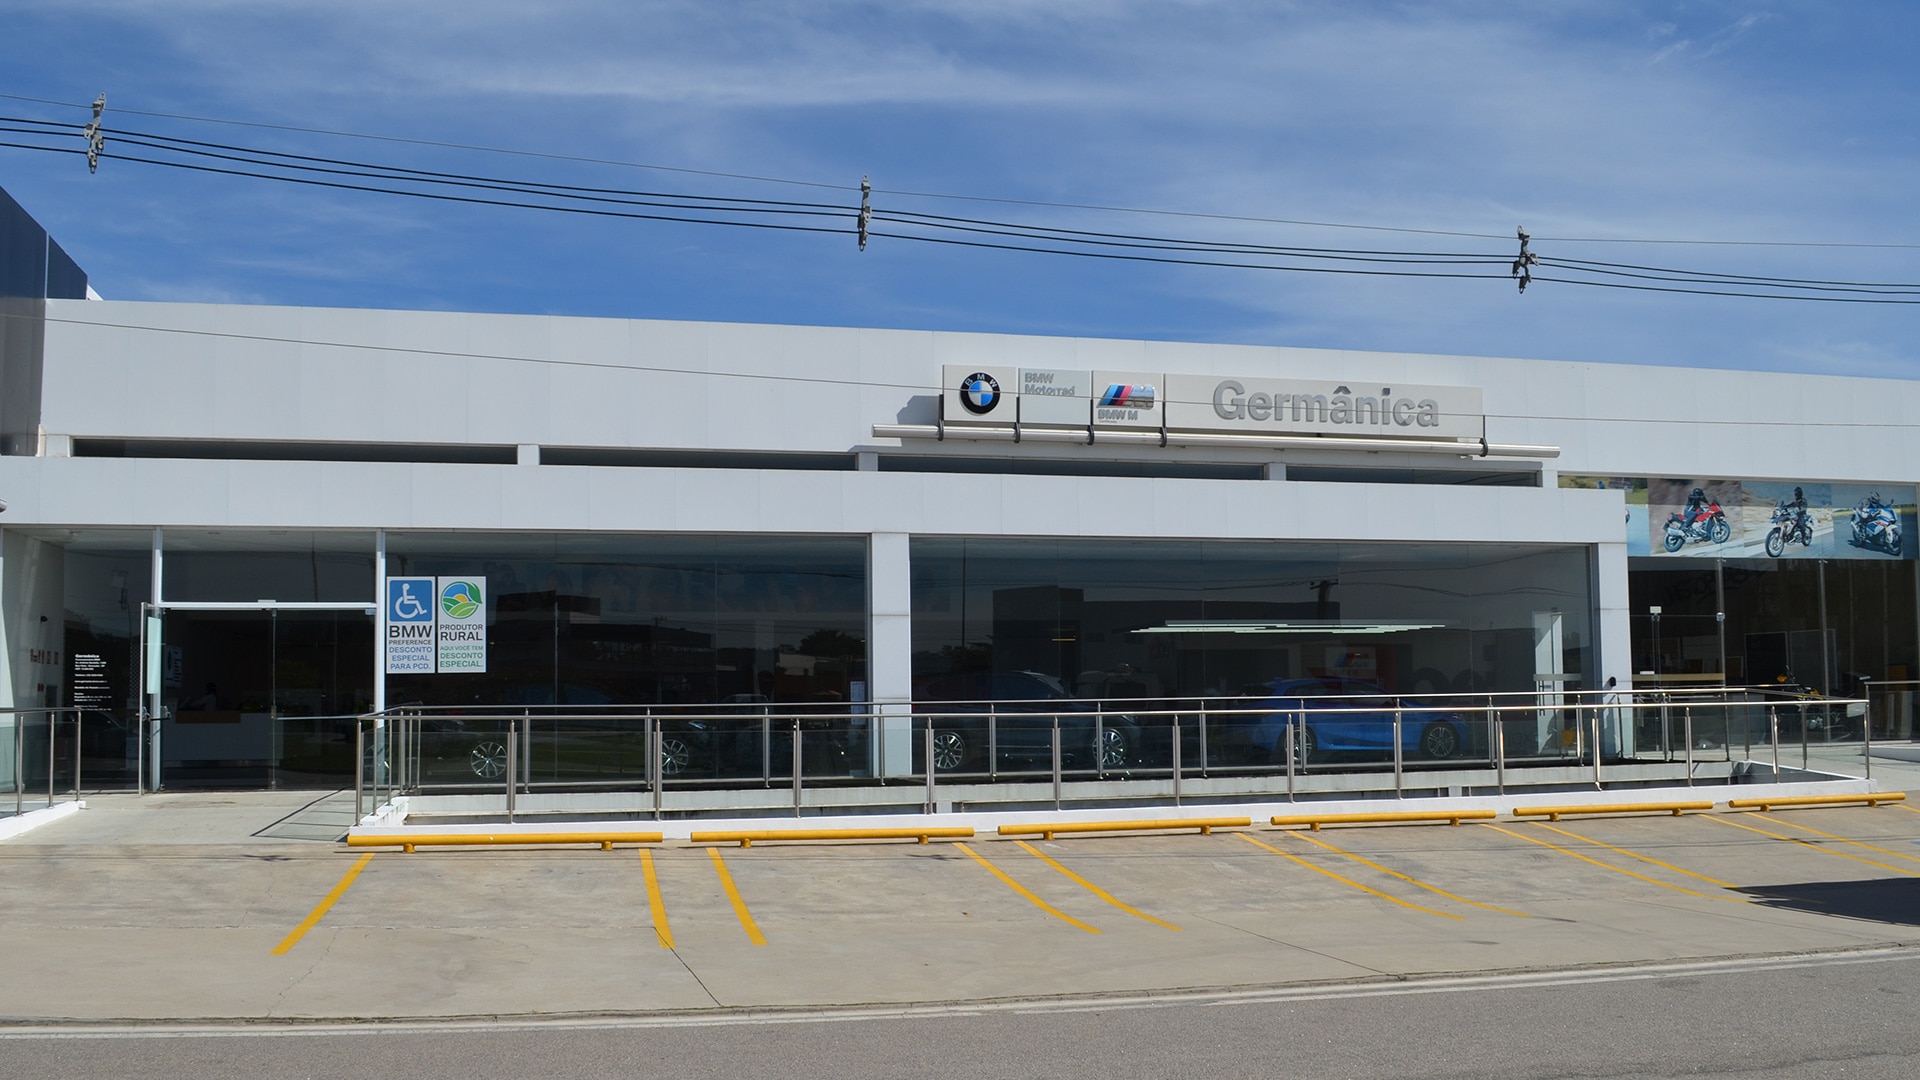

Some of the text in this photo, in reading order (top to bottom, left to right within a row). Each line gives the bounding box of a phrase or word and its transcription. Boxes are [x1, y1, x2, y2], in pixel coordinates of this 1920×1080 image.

[1025, 372, 1055, 384] BMW
[1025, 384, 1076, 397] Motorrad
[1212, 380, 1440, 428] Germânica
[1098, 408, 1139, 421] BMW M
[389, 625, 433, 638] BMW
[440, 632, 483, 641] RURAL
